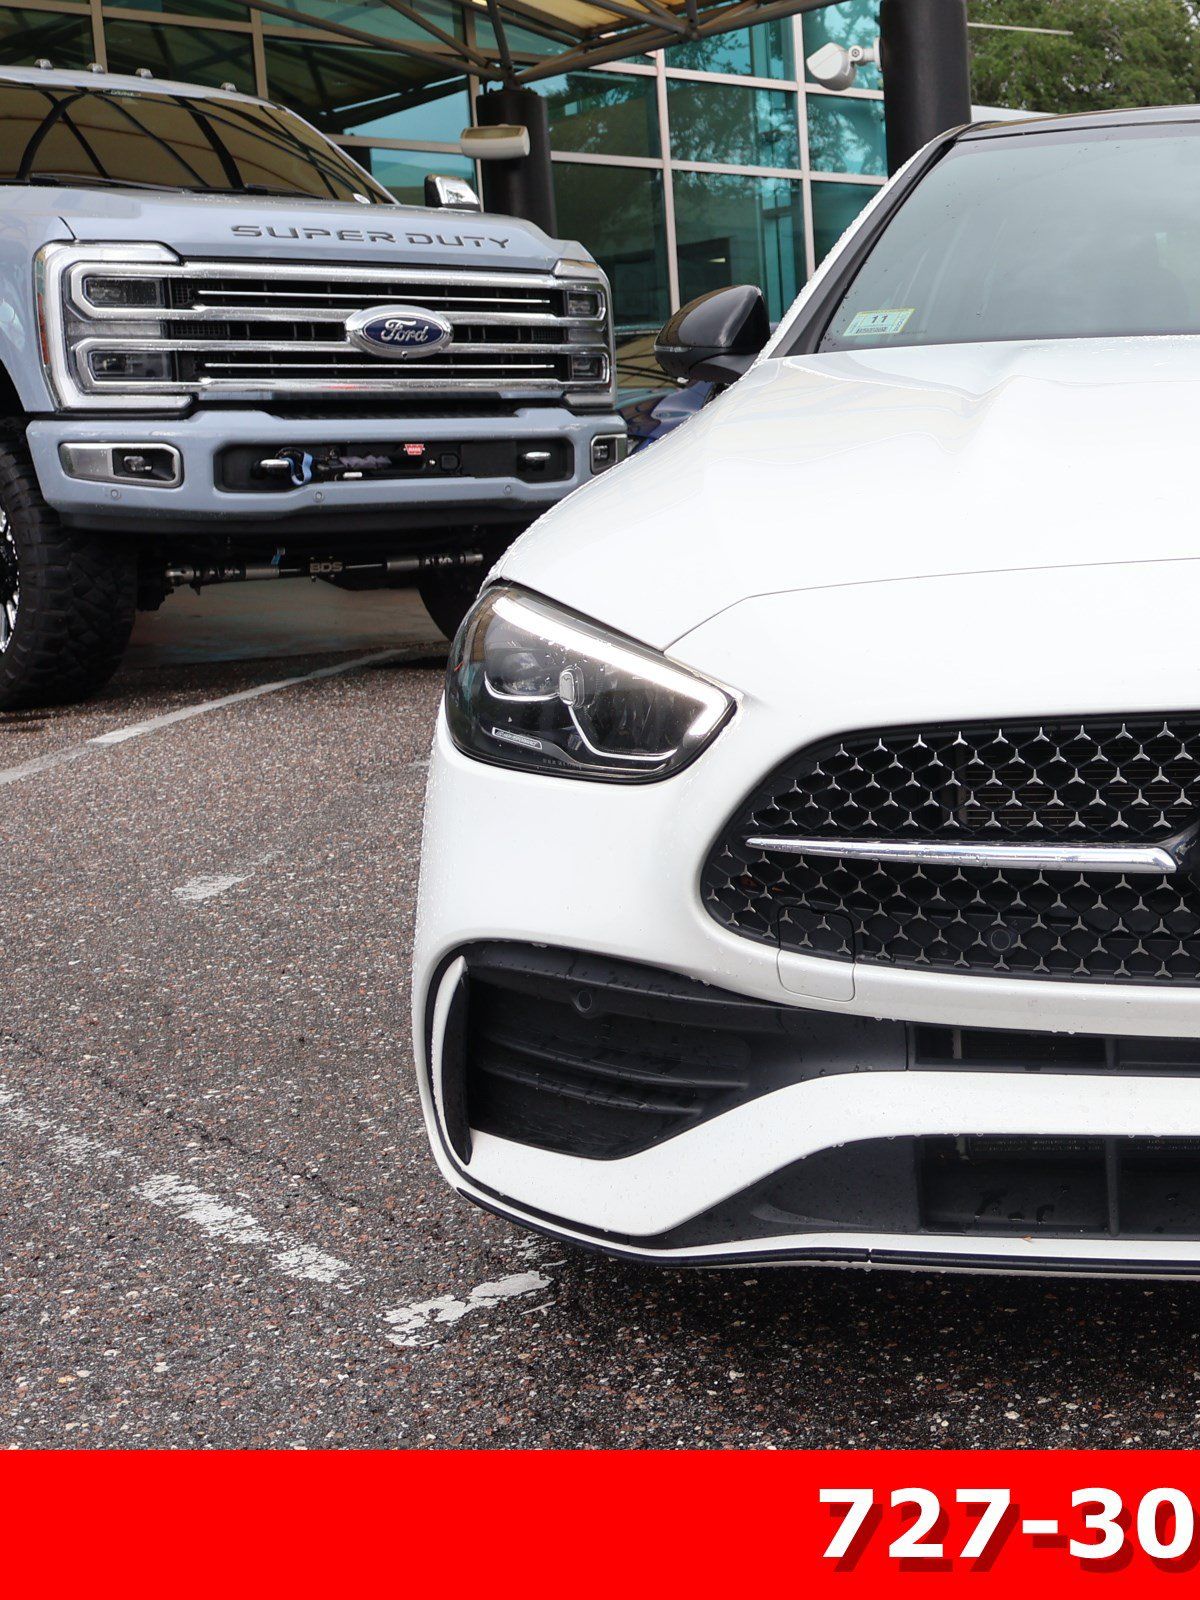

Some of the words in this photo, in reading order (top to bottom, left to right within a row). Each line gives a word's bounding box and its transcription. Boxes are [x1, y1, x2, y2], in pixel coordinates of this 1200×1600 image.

[231, 225, 396, 243] SUPER
[405, 232, 509, 249] DUTY
[871, 315, 888, 324] 11
[381, 319, 429, 342] Ford
[310, 562, 343, 573] BDS
